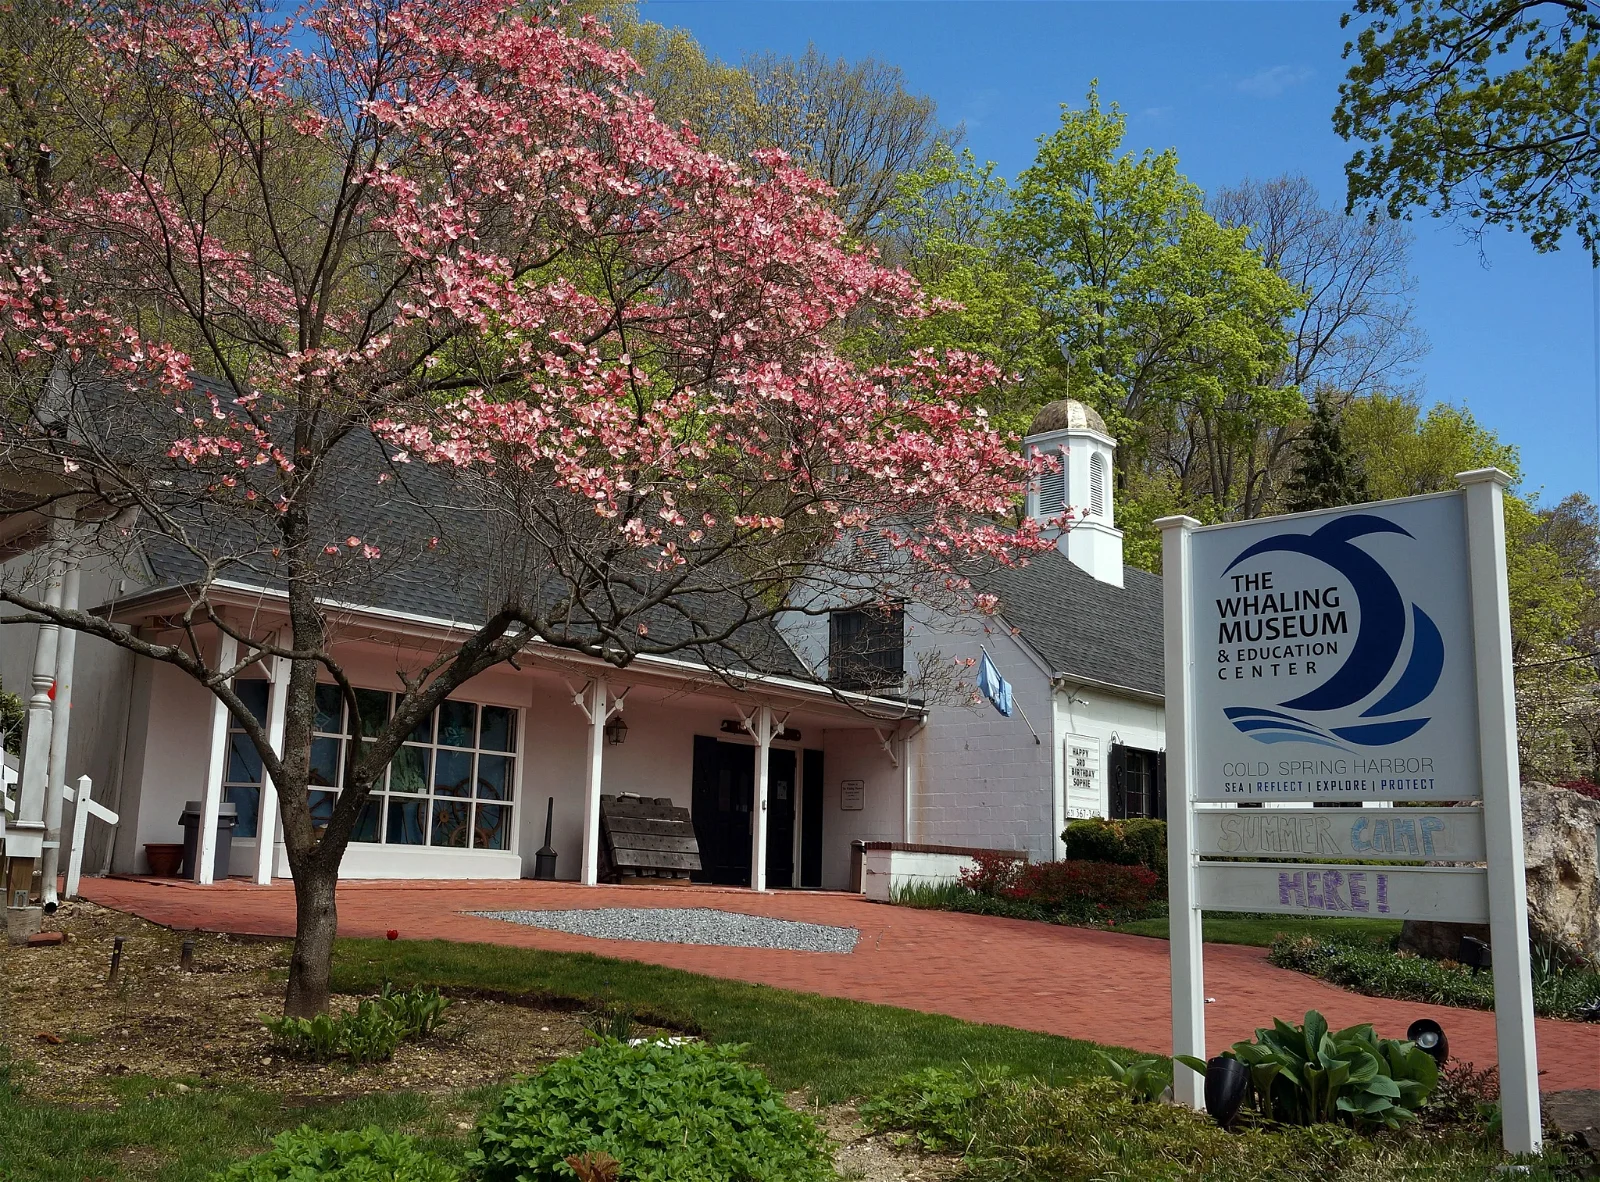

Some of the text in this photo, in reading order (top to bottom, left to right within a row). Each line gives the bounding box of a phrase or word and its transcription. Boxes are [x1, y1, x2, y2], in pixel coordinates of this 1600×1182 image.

[1231, 571, 1274, 593] THE
[1216, 586, 1340, 619] WHALING
[1218, 611, 1348, 644] MUSEUM
[1217, 641, 1338, 663] & EDUCATION
[1218, 661, 1317, 680] CENTER
[1072, 748, 1089, 757] HAPPY
[1076, 758, 1086, 767] 3RD
[1071, 767, 1095, 778] BIRTHDAY
[1223, 757, 1434, 777] COLD SPRING HARBOR
[1073, 778, 1090, 788] SOPHIE
[1225, 778, 1434, 793] SEA REFLECT EXPLORE PROTECT
[1216, 814, 1445, 856] SUMMER CAMP
[1278, 870, 1390, 914] HERE!
